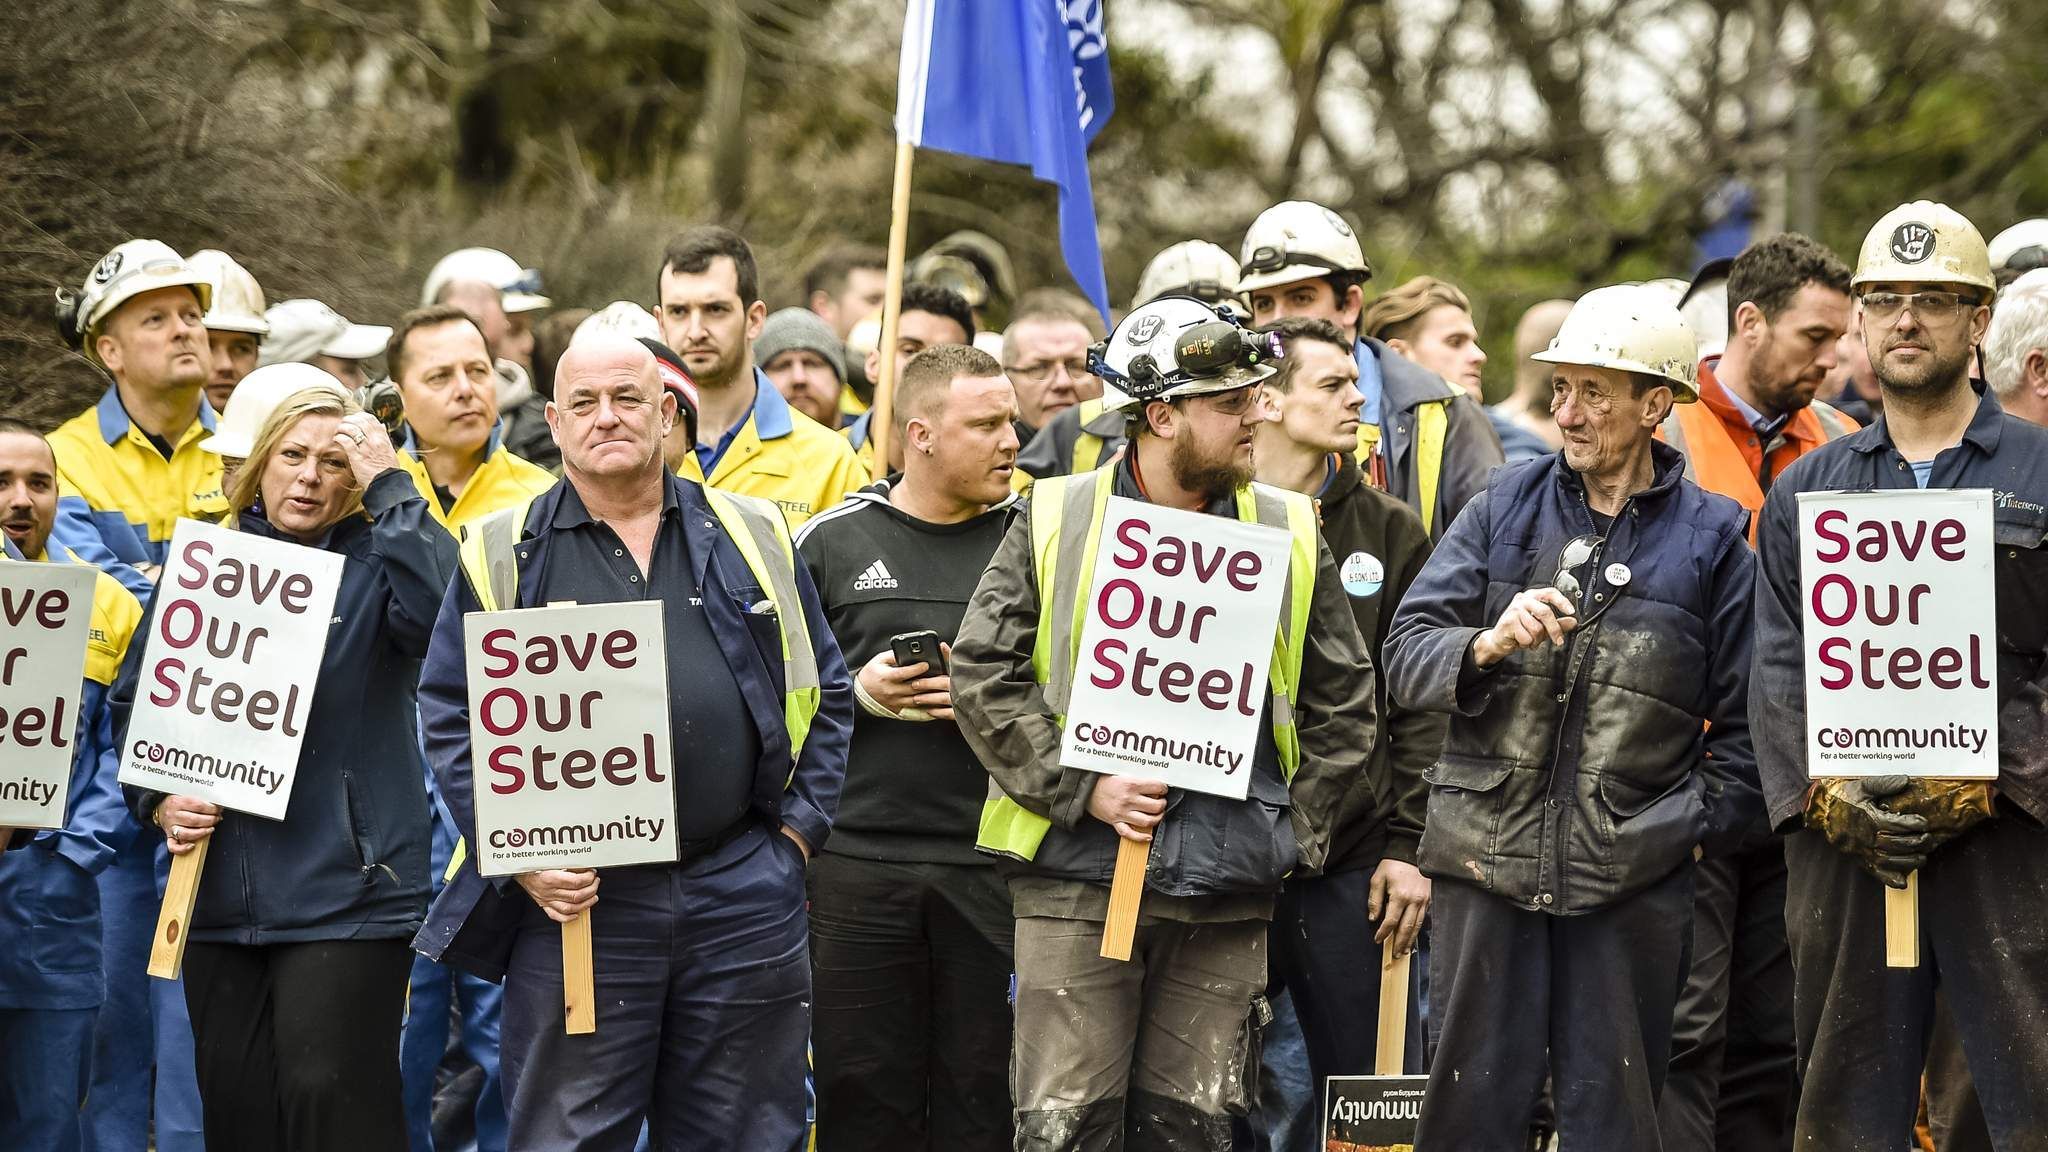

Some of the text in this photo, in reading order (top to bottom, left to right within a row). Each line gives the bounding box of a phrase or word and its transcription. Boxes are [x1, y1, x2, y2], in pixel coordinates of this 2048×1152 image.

[1113, 518, 1262, 592] Save
[1814, 509, 1967, 563] Save
[177, 540, 313, 614] Save
[853, 577, 899, 590] adidas
[1811, 573, 1931, 627] Our
[160, 598, 269, 665] Our
[1097, 578, 1217, 644] Our
[481, 628, 638, 679] Save
[1090, 638, 1255, 717] Steel
[1818, 633, 1990, 691] Steel
[149, 657, 299, 738] Steel
[480, 687, 603, 737] Our
[488, 733, 666, 795] Steel
[1074, 722, 1244, 775] community
[1074, 744, 1085, 753] For
[1092, 747, 1115, 759] better
[1116, 753, 1147, 766] working
[1147, 759, 1169, 769] world
[1817, 722, 1988, 754] community
[1820, 752, 1832, 760] For
[1838, 752, 1861, 760] better
[1862, 752, 1893, 761] working
[1893, 752, 1916, 760] world
[0, 777, 58, 807] nity
[131, 761, 143, 770] For
[147, 765, 167, 776] better
[168, 771, 194, 784] working
[194, 777, 214, 787] world
[133, 739, 285, 795] community
[489, 815, 665, 849] community
[512, 850, 535, 858] better
[536, 848, 568, 857] working
[569, 846, 592, 854] world
